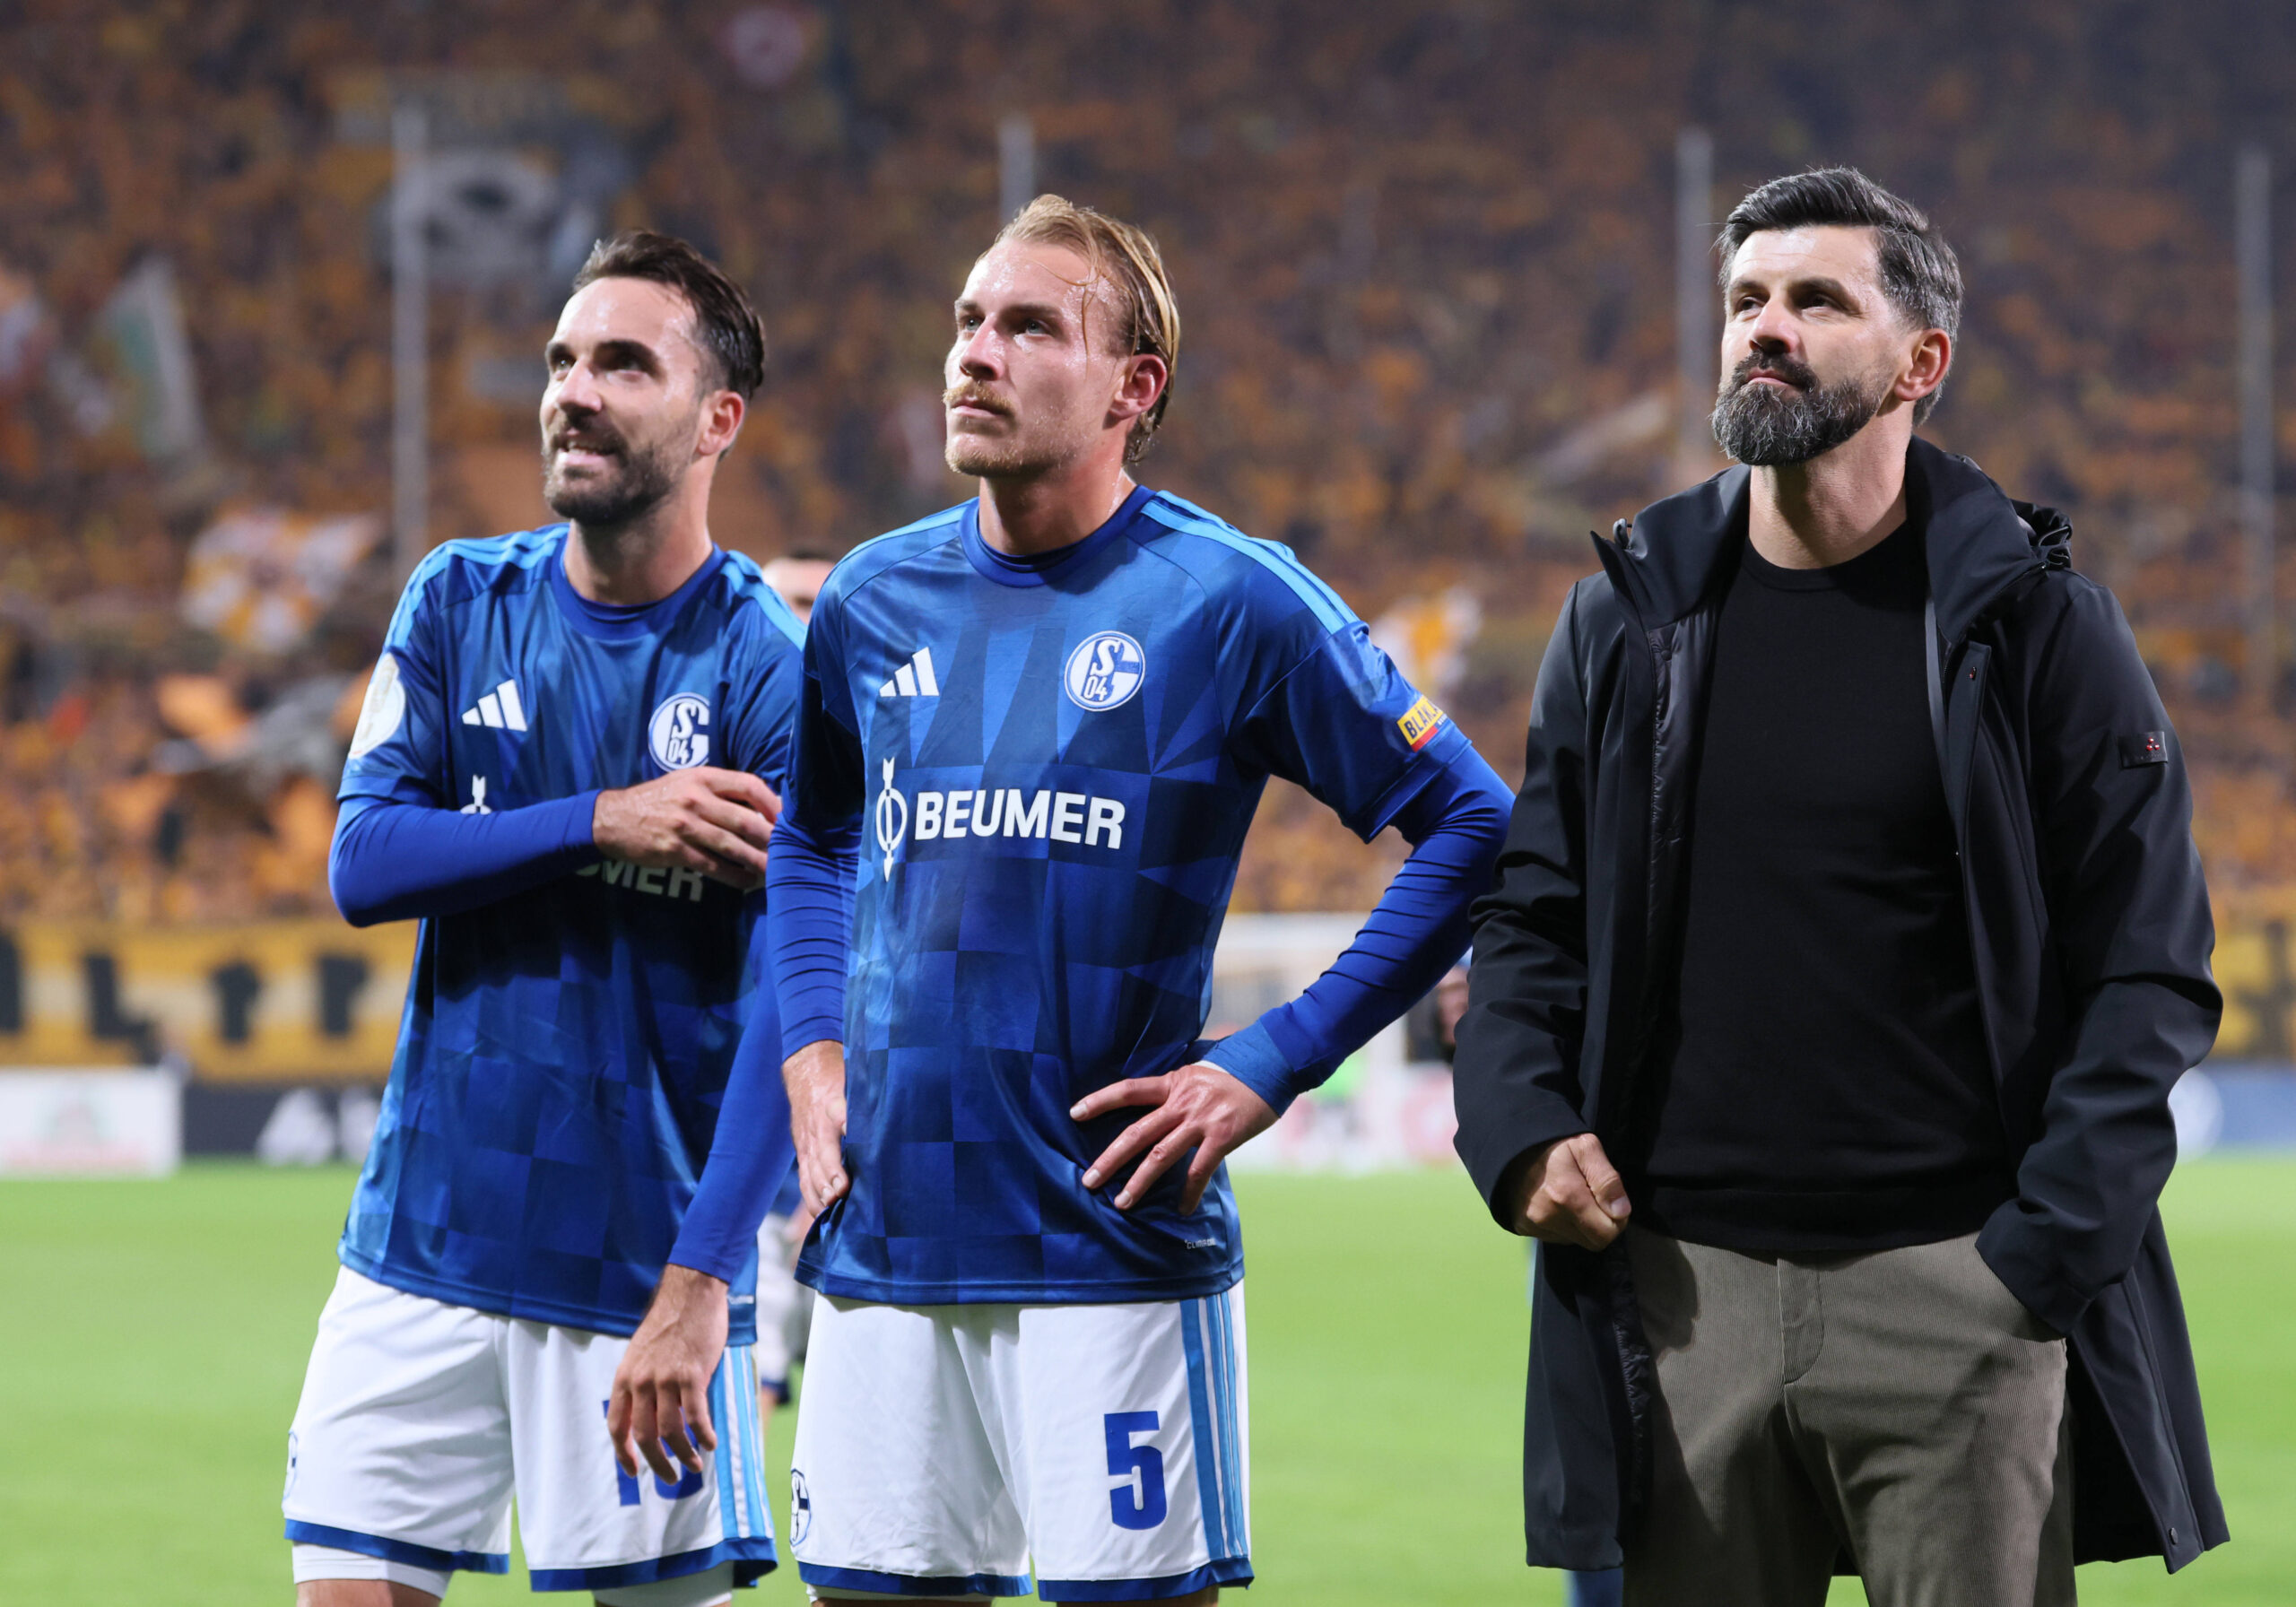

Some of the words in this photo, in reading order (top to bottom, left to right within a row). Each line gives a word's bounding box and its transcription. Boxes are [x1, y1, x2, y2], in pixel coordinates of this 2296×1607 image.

[1083, 675, 1108, 701] 04
[667, 738, 690, 765] 04
[915, 788, 1126, 850] BEUMER
[1103, 1410, 1168, 1531] 5
